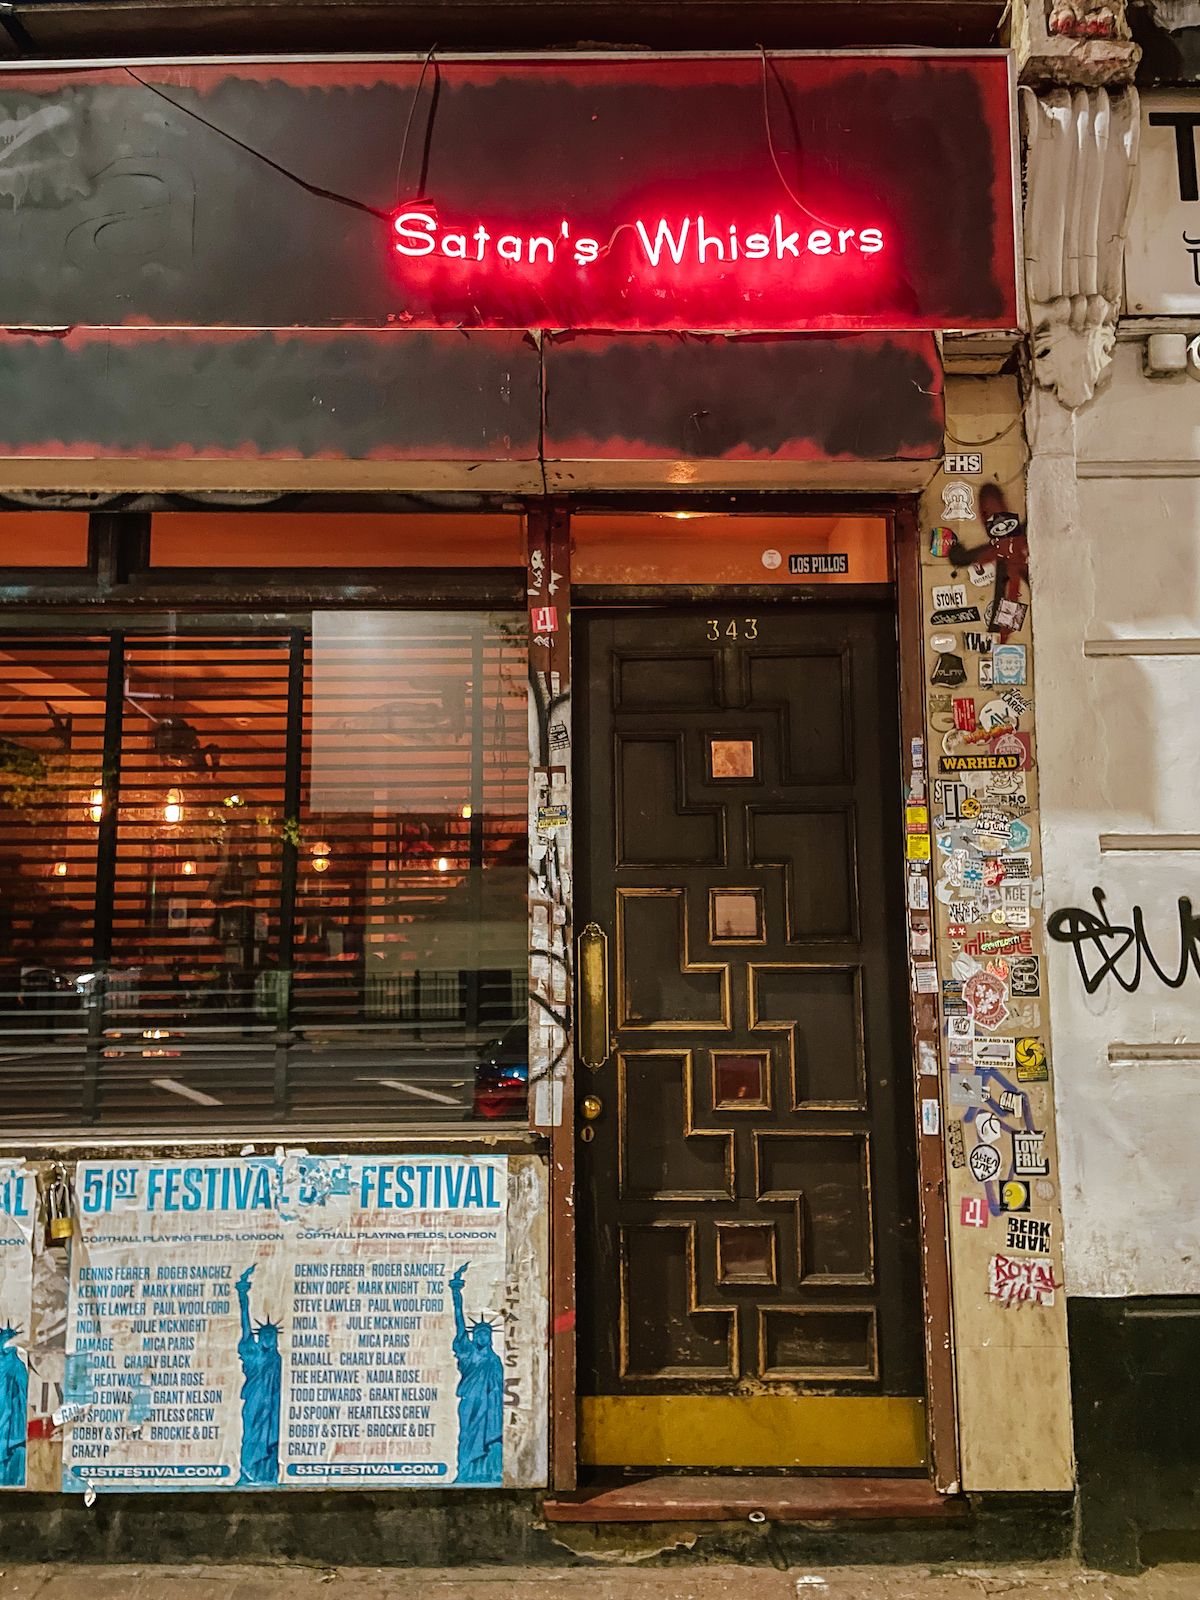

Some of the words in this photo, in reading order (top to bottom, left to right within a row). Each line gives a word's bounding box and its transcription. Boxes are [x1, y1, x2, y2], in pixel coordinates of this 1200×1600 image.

[394, 212, 599, 267] Satan's
[635, 212, 886, 267] Whiskers
[945, 455, 981, 471] FHS
[791, 557, 810, 573] LOS
[812, 556, 846, 573] PILLOS
[936, 592, 963, 607] STONEY
[706, 618, 758, 641] 343
[1002, 693, 1026, 716] LARGE
[942, 756, 1018, 770] WARHEAD
[83, 1168, 138, 1213] 51ST
[360, 1165, 500, 1209] FESTIVAL
[1008, 1217, 1051, 1237] BERK
[81, 1234, 141, 1243] COPTHALL
[143, 1234, 192, 1242] PLAYING
[236, 1233, 284, 1241] LONDON
[296, 1232, 356, 1240] COPTHALL
[449, 1231, 497, 1239] LONDON
[79, 1267, 113, 1281] DENNIS
[115, 1266, 150, 1280] FERRER
[157, 1266, 188, 1280] ROGER
[190, 1265, 232, 1279] SANCHEZ
[294, 1264, 329, 1277] DENNIS
[330, 1264, 365, 1277] FERRER
[372, 1264, 401, 1277] ROGER
[403, 1263, 445, 1277] SANCHEZ
[78, 1285, 108, 1299] KENNY
[110, 1285, 135, 1298] DOPE
[142, 1284, 168, 1298] MARK
[171, 1284, 205, 1297] KNIGHT
[213, 1283, 230, 1297] TXC
[293, 1281, 324, 1295] KENNY
[326, 1281, 350, 1294] DOPE
[357, 1281, 383, 1294] MARK
[385, 1281, 419, 1294] KNIGHT
[426, 1281, 444, 1294] TXC
[77, 1303, 107, 1316] STEVE
[108, 1302, 146, 1316] LAWLER
[153, 1302, 176, 1315] PAUL
[179, 1301, 230, 1315] WOOLFORD
[293, 1299, 323, 1312] STEVE
[324, 1299, 361, 1312] LAWLER
[368, 1299, 391, 1312] PAUL
[393, 1298, 444, 1312] WOOLFORD
[76, 1320, 101, 1334] INDIA
[131, 1320, 157, 1333] JULIE
[159, 1319, 207, 1333] MCKNIGHT
[292, 1317, 317, 1330] INDIA
[346, 1316, 372, 1330] JULIE
[374, 1316, 422, 1330] MCKNIGHT
[75, 1338, 114, 1351] DAMAGE
[142, 1337, 166, 1351] MICA
[168, 1337, 195, 1350] PARIS
[291, 1334, 330, 1348] DAMAGE
[358, 1334, 381, 1348] MICA
[383, 1334, 410, 1348] PARIS
[124, 1355, 158, 1369] CHARLY
[160, 1355, 191, 1368] BLACK
[291, 1352, 333, 1366] RANDALL
[340, 1352, 374, 1366] CHARLY
[376, 1352, 406, 1365] BLACK
[94, 1373, 143, 1387] HEATWAVE
[151, 1373, 178, 1386] NADIA
[180, 1372, 204, 1386] ROSE
[290, 1370, 309, 1384] THE
[310, 1370, 359, 1383] HEATWAVE
[366, 1370, 394, 1383] NADIA
[395, 1369, 420, 1383] ROSE
[153, 1390, 184, 1404] GRANT
[186, 1390, 222, 1404] NELSON
[290, 1388, 316, 1402] TODD
[317, 1388, 362, 1401] EDWARDS
[369, 1388, 400, 1401] GRANT
[401, 1387, 438, 1401] NELSON
[88, 1409, 124, 1423] SPOONY
[186, 1408, 215, 1422] CREW
[289, 1406, 301, 1420] DJ
[303, 1406, 340, 1420] SPOONY
[347, 1405, 400, 1419] HEARTLESS
[402, 1405, 430, 1419] CREW
[72, 1427, 102, 1441] BOBBY
[104, 1427, 113, 1440] &
[151, 1426, 191, 1440] BROCKIE
[192, 1426, 200, 1440] &
[202, 1426, 220, 1439] DET
[288, 1424, 320, 1438] BOBBY
[321, 1424, 329, 1438] &
[330, 1424, 360, 1437] STEVE
[366, 1423, 407, 1437] BROCKIE
[408, 1423, 416, 1437] &
[418, 1423, 436, 1437] DET
[72, 1444, 102, 1458] CRAZY
[103, 1444, 110, 1458] P
[288, 1442, 318, 1456] CRAZY
[319, 1442, 326, 1456] P
[80, 1467, 222, 1477] 51STFESTIVAL.COM
[295, 1464, 439, 1475] 51STFESTIVAL.COM
